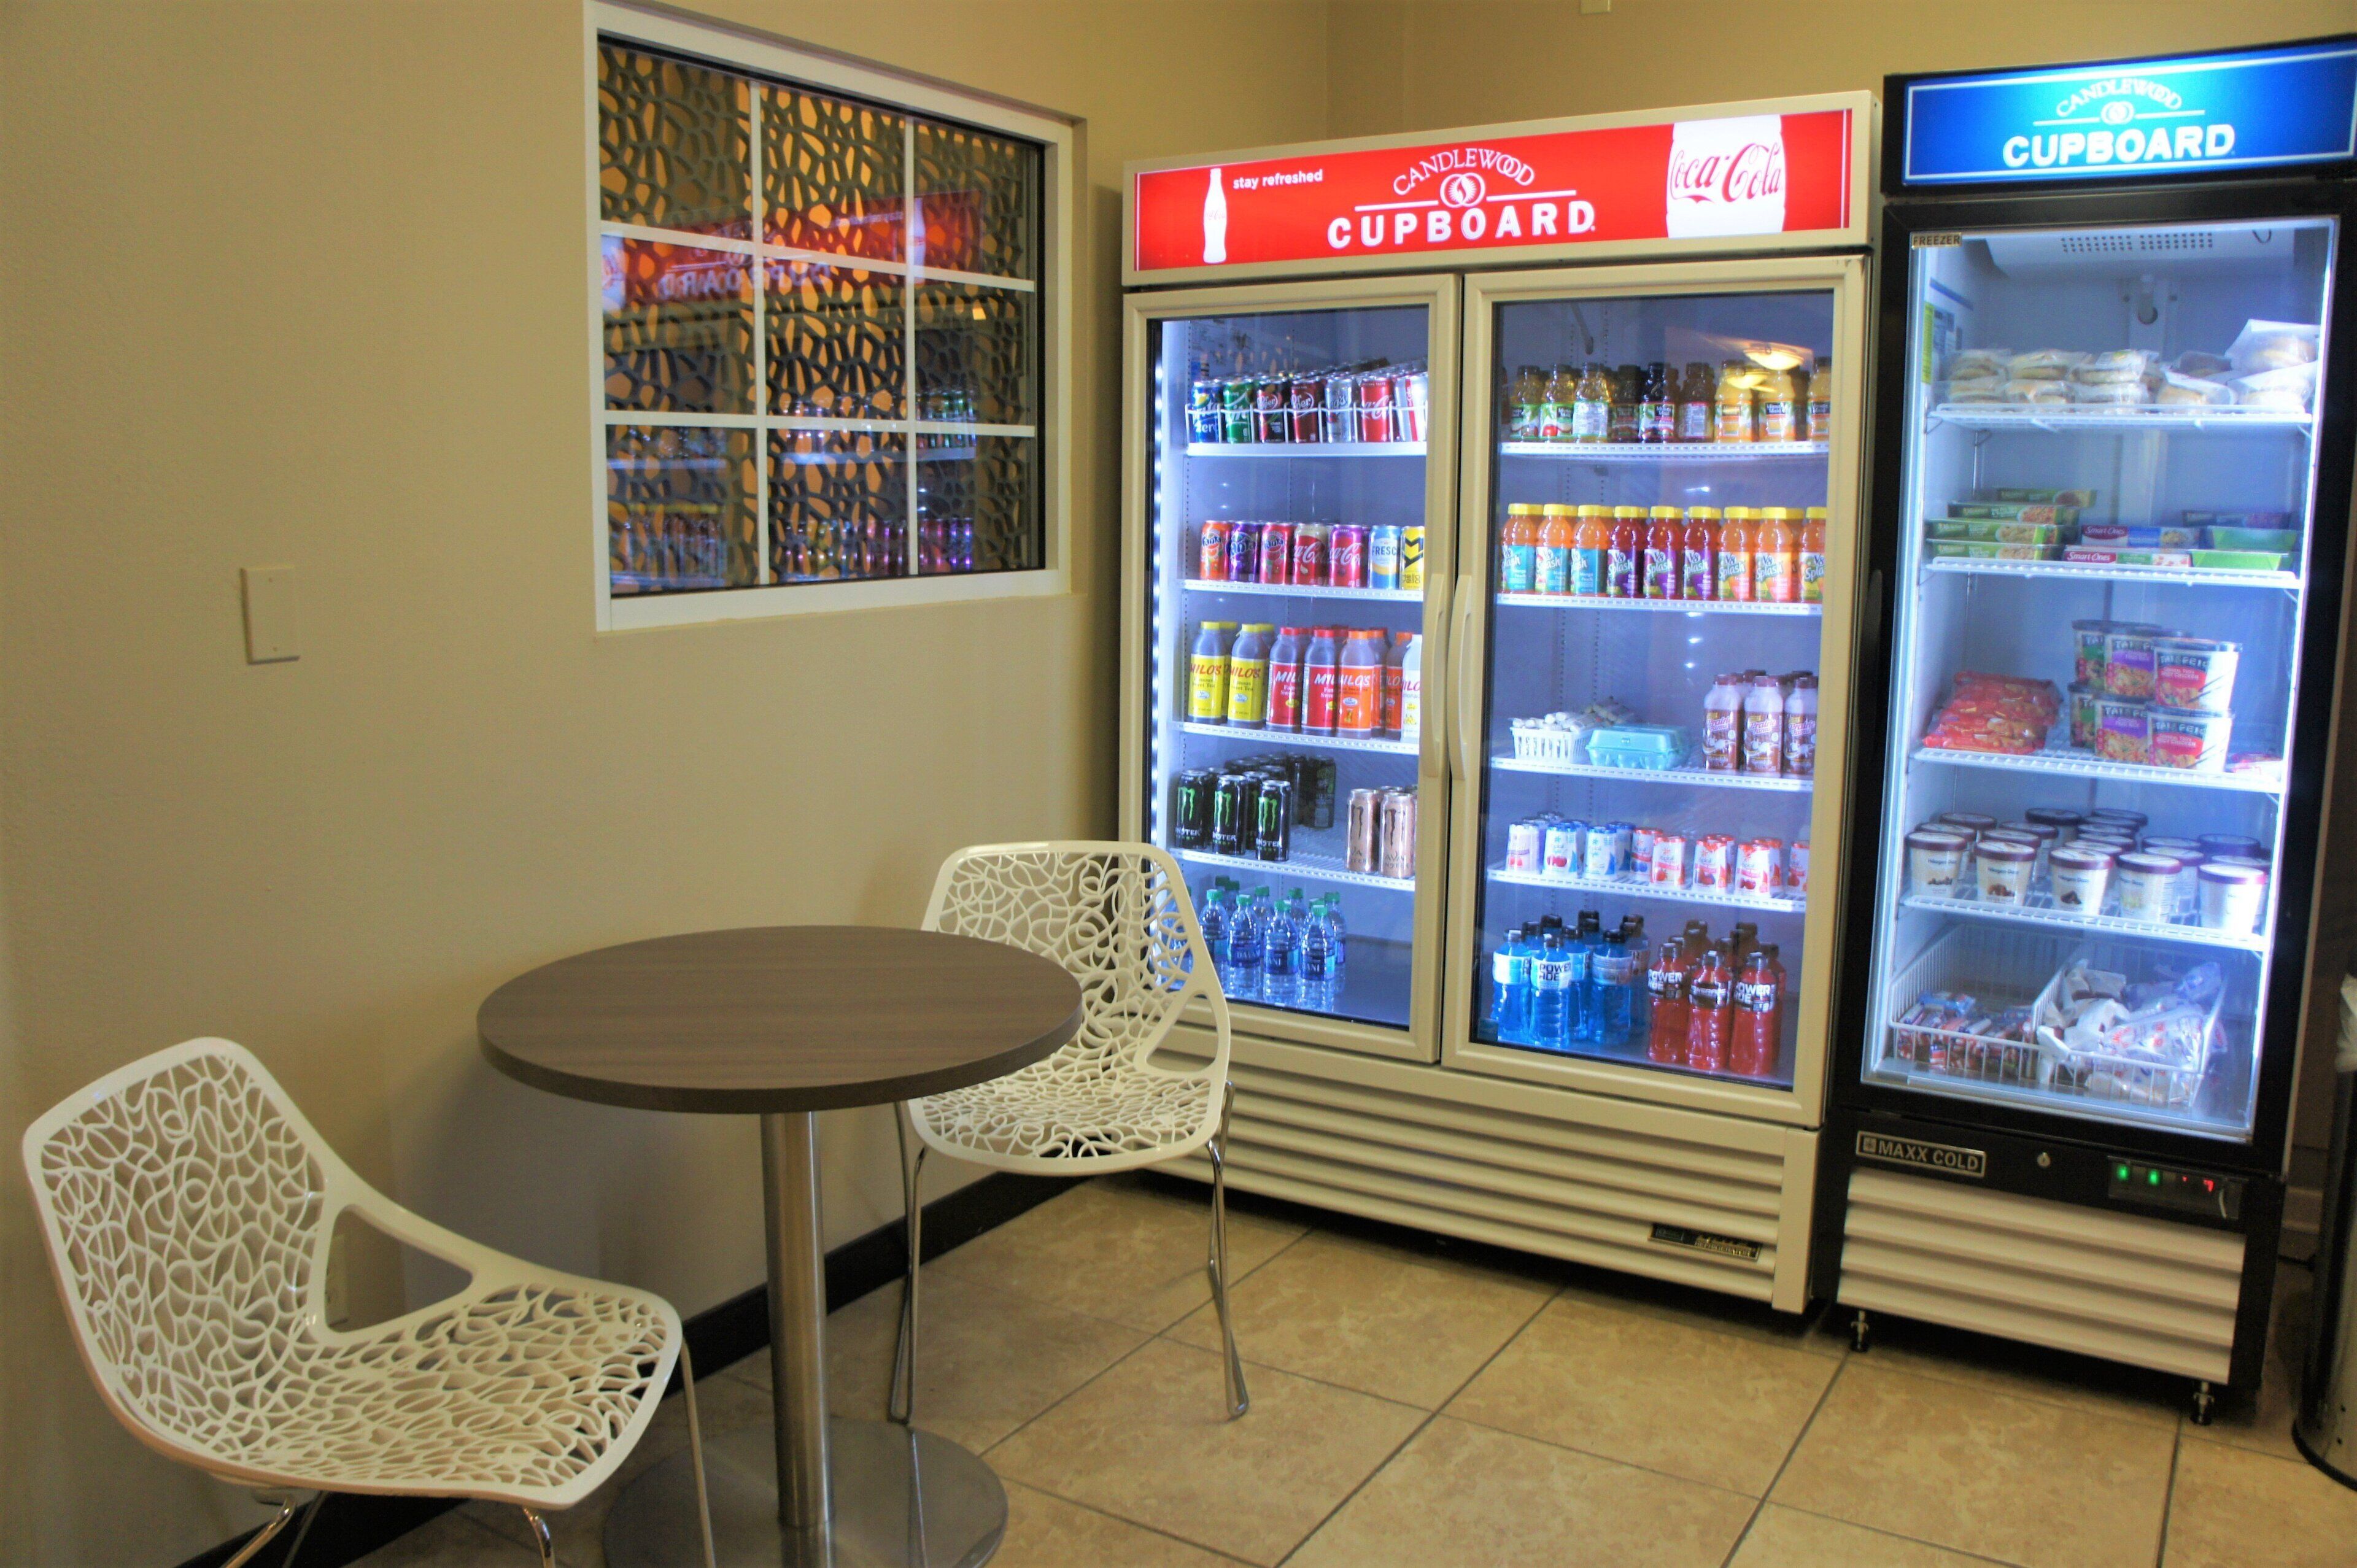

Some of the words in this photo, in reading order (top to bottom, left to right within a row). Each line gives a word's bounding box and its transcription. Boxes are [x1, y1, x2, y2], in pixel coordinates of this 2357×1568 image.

[2056, 78, 2183, 117] CANDLEWOOD
[2003, 124, 2235, 167] CUPBOARD
[1393, 147, 1535, 196] CANDLEWOOD
[1670, 142, 1782, 203] Coca-Cola
[1233, 176, 1259, 190] stay
[1262, 169, 1323, 187] refreshed
[1913, 234, 1960, 246] FREEZER
[2085, 526, 2106, 535] Smart
[2107, 526, 2124, 535] Ones
[1372, 546, 1397, 556] FRESC
[1616, 551, 1626, 562] V8
[1654, 551, 1666, 562] V8
[1689, 551, 1701, 562] V8
[2067, 552, 2091, 561] Smart
[2091, 553, 2111, 562] Ones
[1725, 553, 1736, 565] V8
[1762, 553, 1773, 565] V8
[1814, 553, 1824, 565] V8
[1647, 558, 1673, 576] Splash
[1719, 562, 1746, 580] Splash
[1757, 562, 1784, 580] Splash
[1805, 563, 1824, 580] Spla
[1878, 1140, 1929, 1162] MAXX
[1933, 1149, 1979, 1171] COLD
